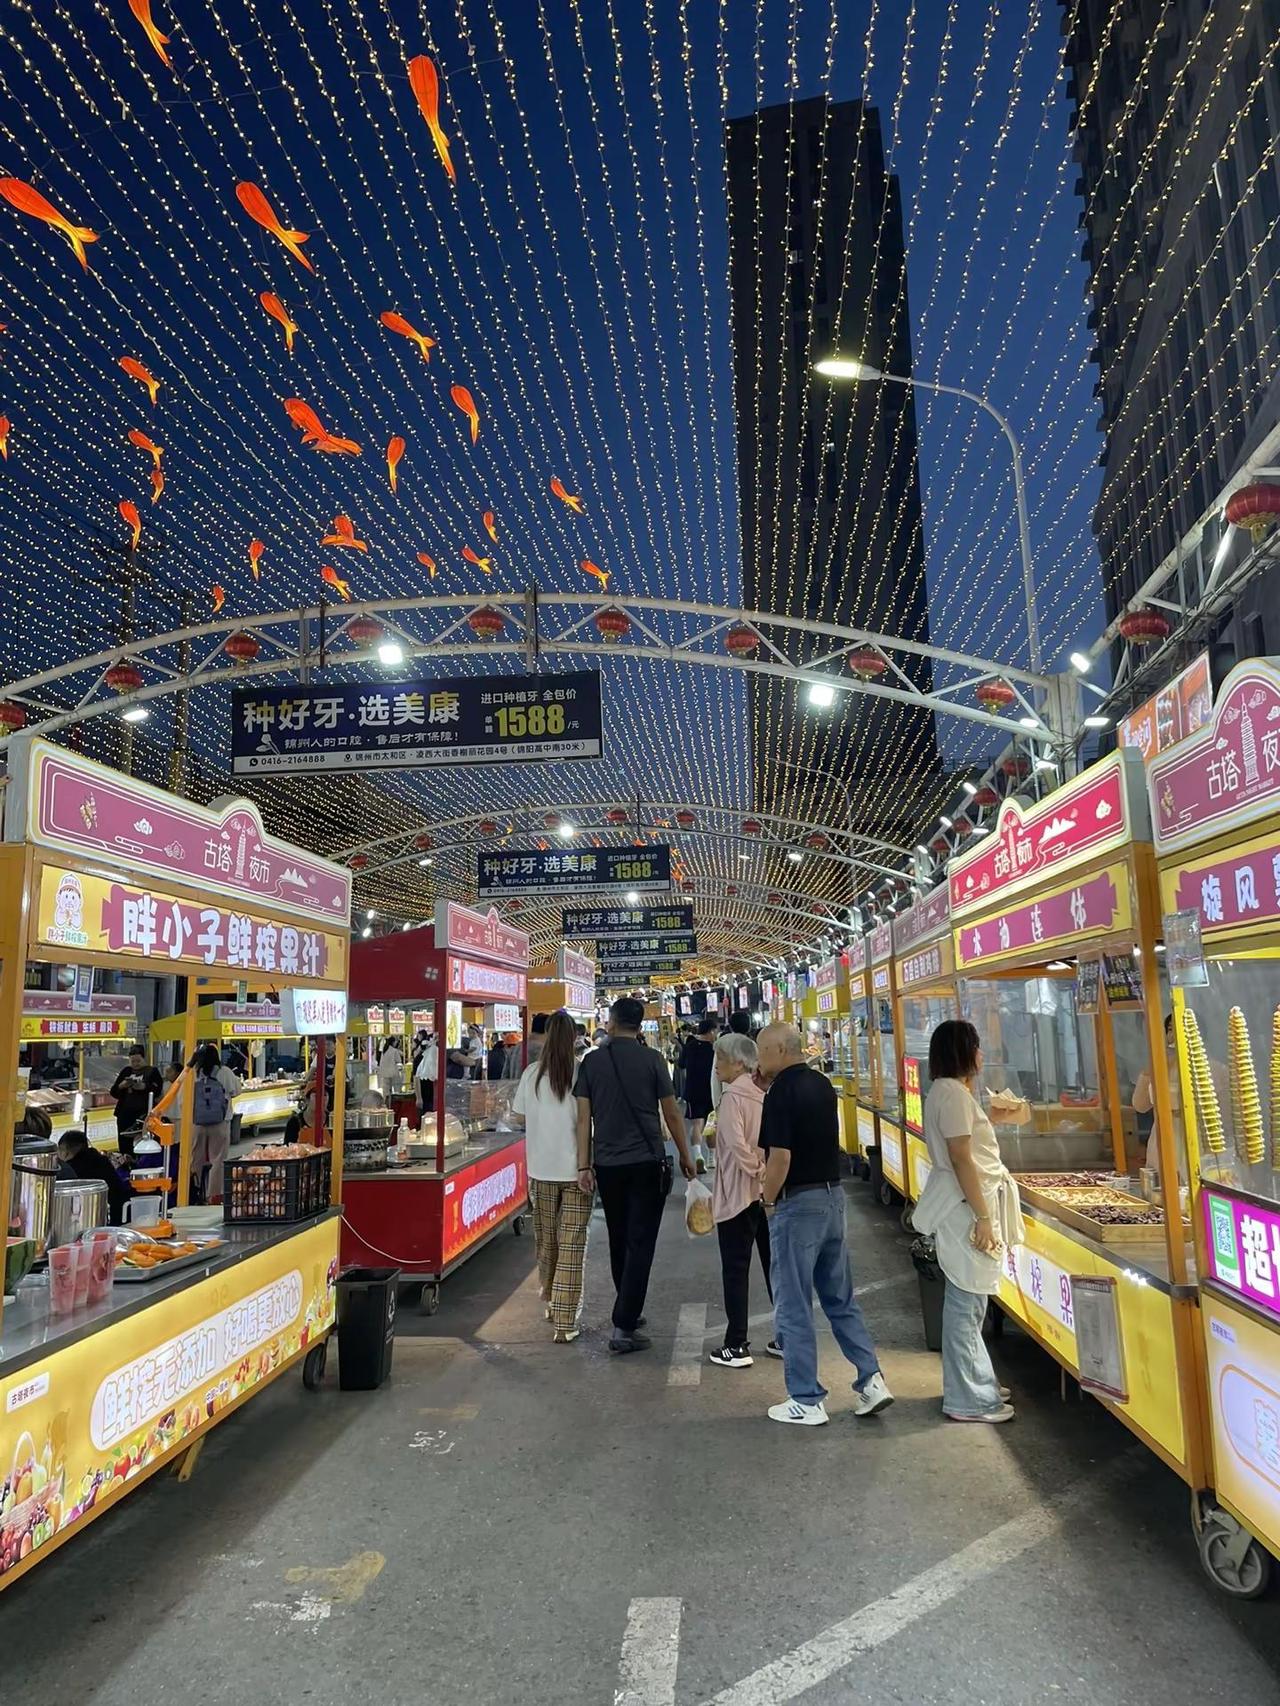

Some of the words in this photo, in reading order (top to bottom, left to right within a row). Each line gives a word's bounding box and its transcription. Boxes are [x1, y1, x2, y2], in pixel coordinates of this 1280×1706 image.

[243, 691, 461, 733] 种好牙·选美康
[480, 691, 539, 705] 进口种植牙
[543, 688, 577, 702] 全包价
[494, 703, 566, 737] 1588
[261, 754, 326, 766] 0416-2164888
[1207, 750, 1242, 800] 古塔
[204, 838, 234, 873] 古塔
[249, 856, 271, 884] 夜市
[483, 855, 598, 877] 种好牙·选美康
[614, 862, 652, 879] 1588
[1201, 853, 1280, 923] 旋风
[122, 892, 321, 978] 胖小子鲜榨果汁
[1240, 1214, 1280, 1298] 超
[101, 1328, 218, 1446] 鲜榨无添加
